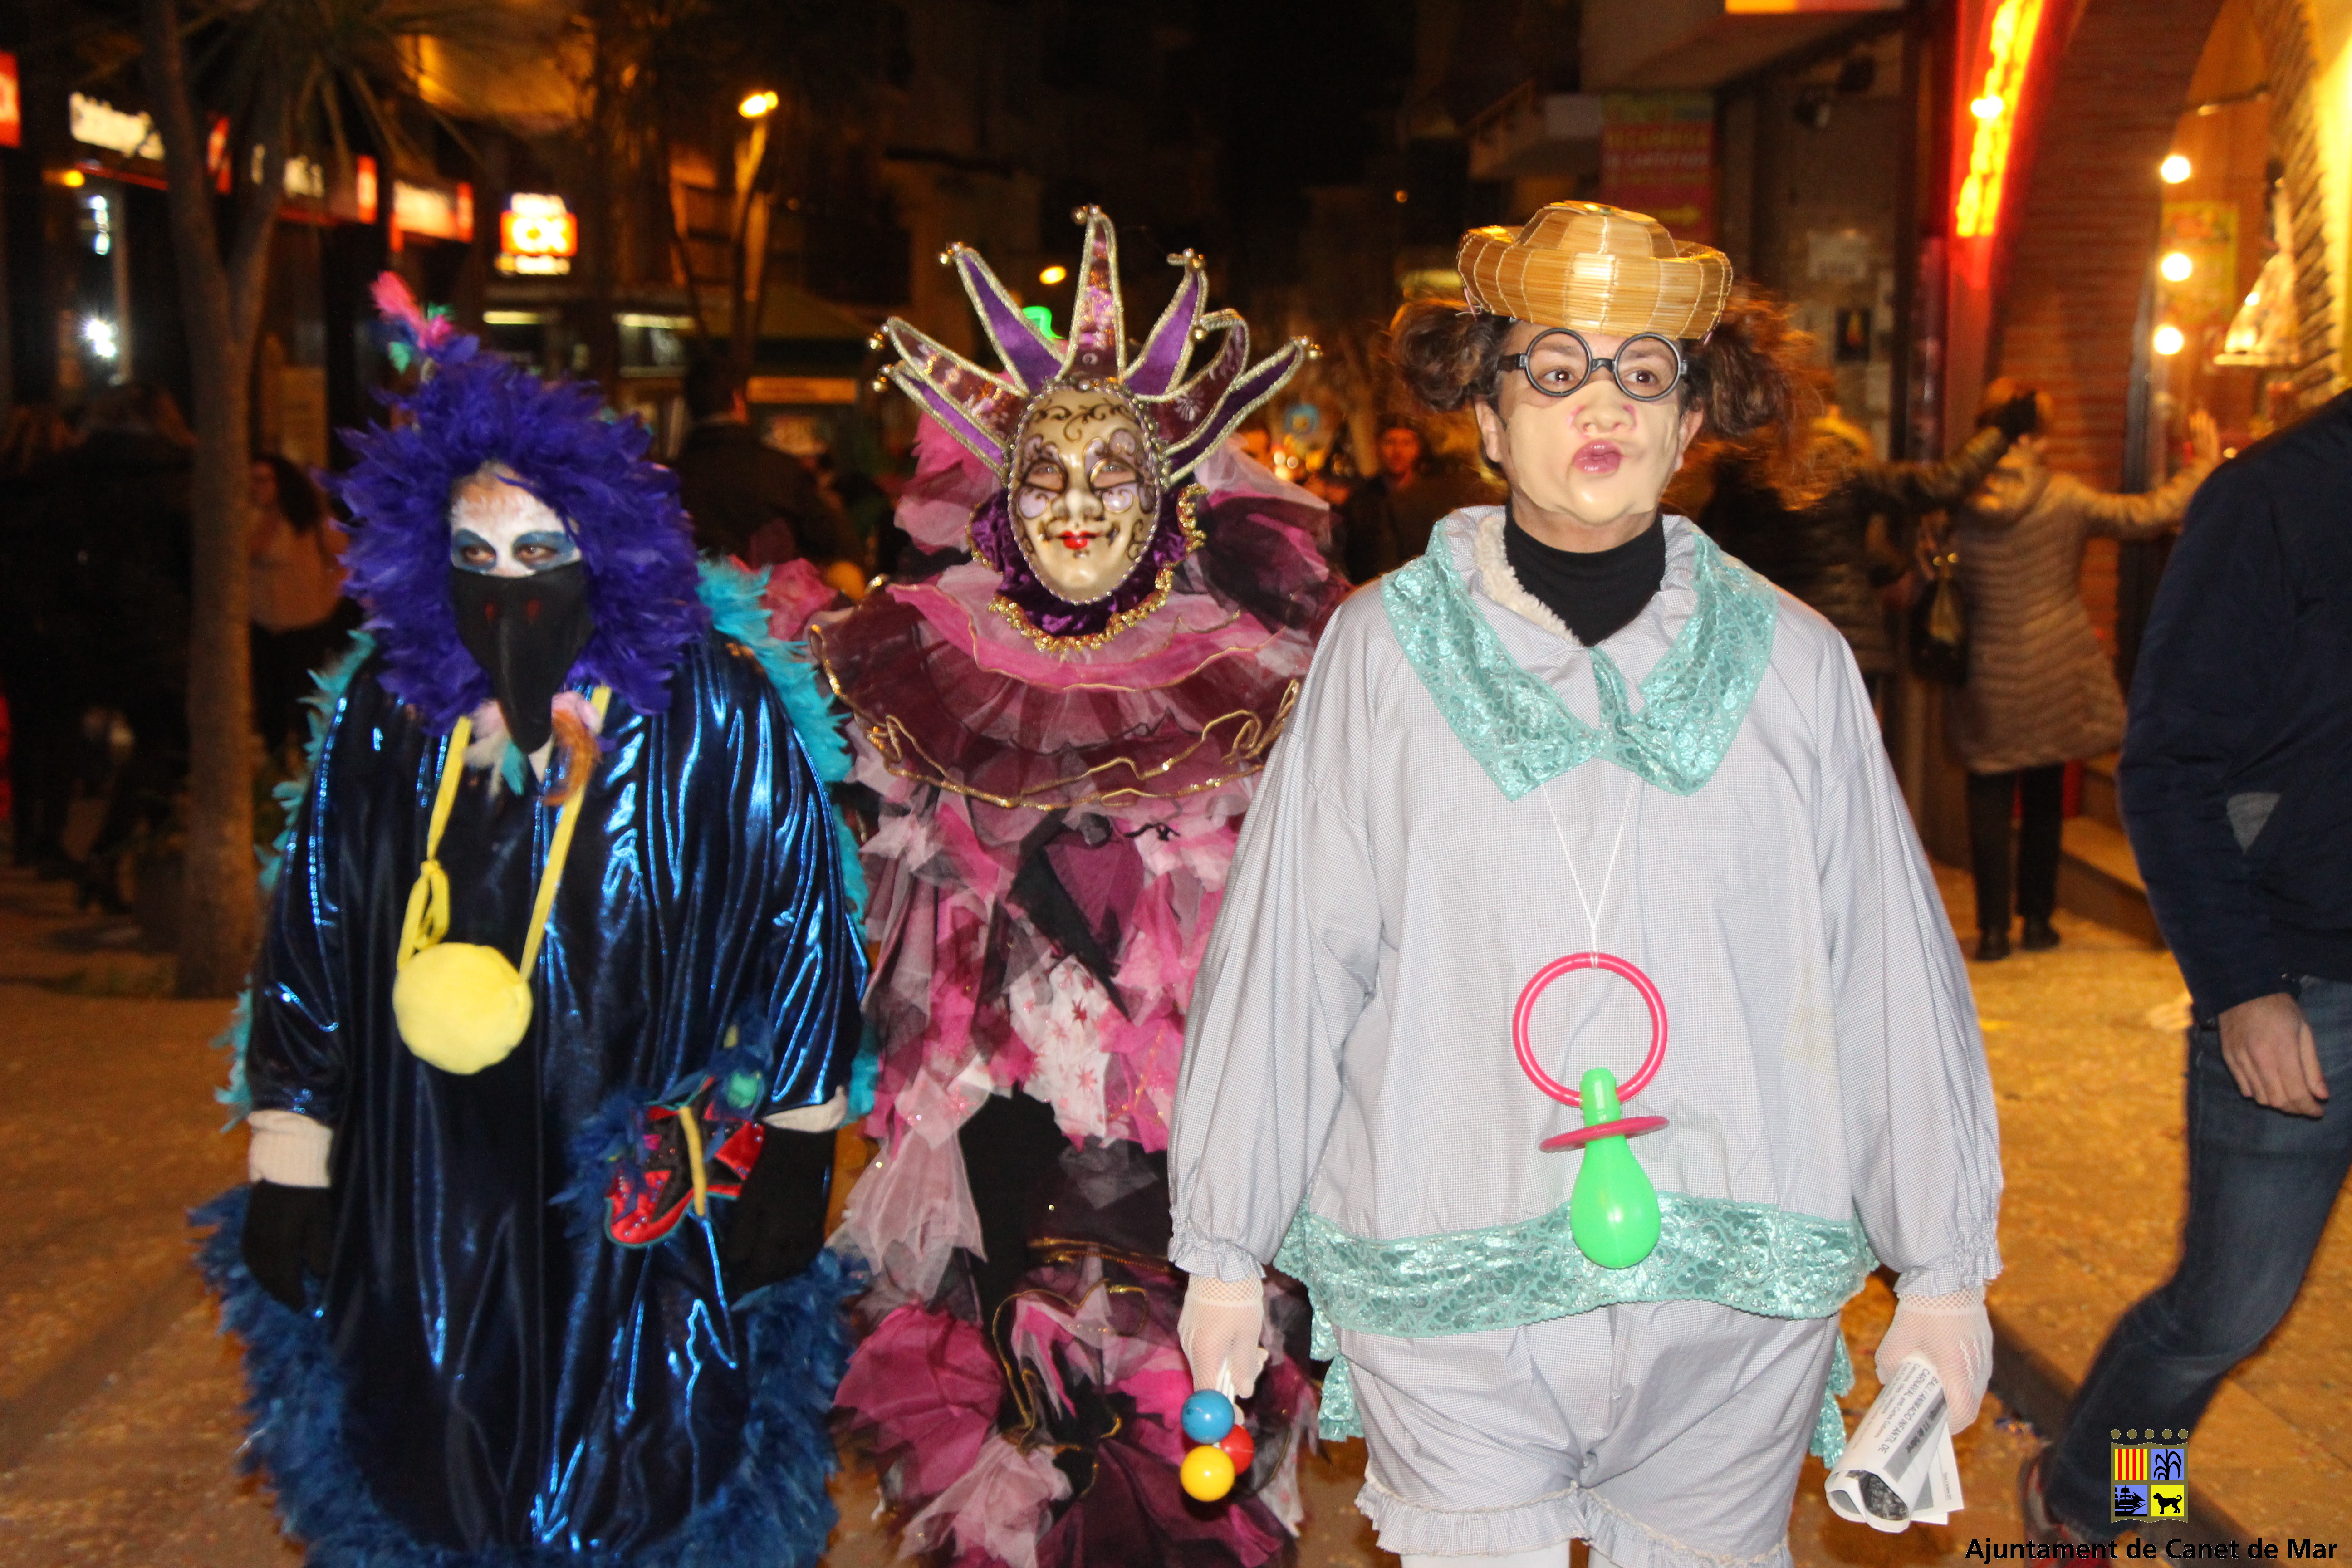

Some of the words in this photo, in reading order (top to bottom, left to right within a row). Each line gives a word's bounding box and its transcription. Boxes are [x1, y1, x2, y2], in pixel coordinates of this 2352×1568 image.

[1903, 1367, 1930, 1397] CARNAVAL
[1925, 1376, 1939, 1392] BALL
[1883, 1418, 1908, 1444] INFANTIL
[1877, 1443, 1890, 1454] DE
